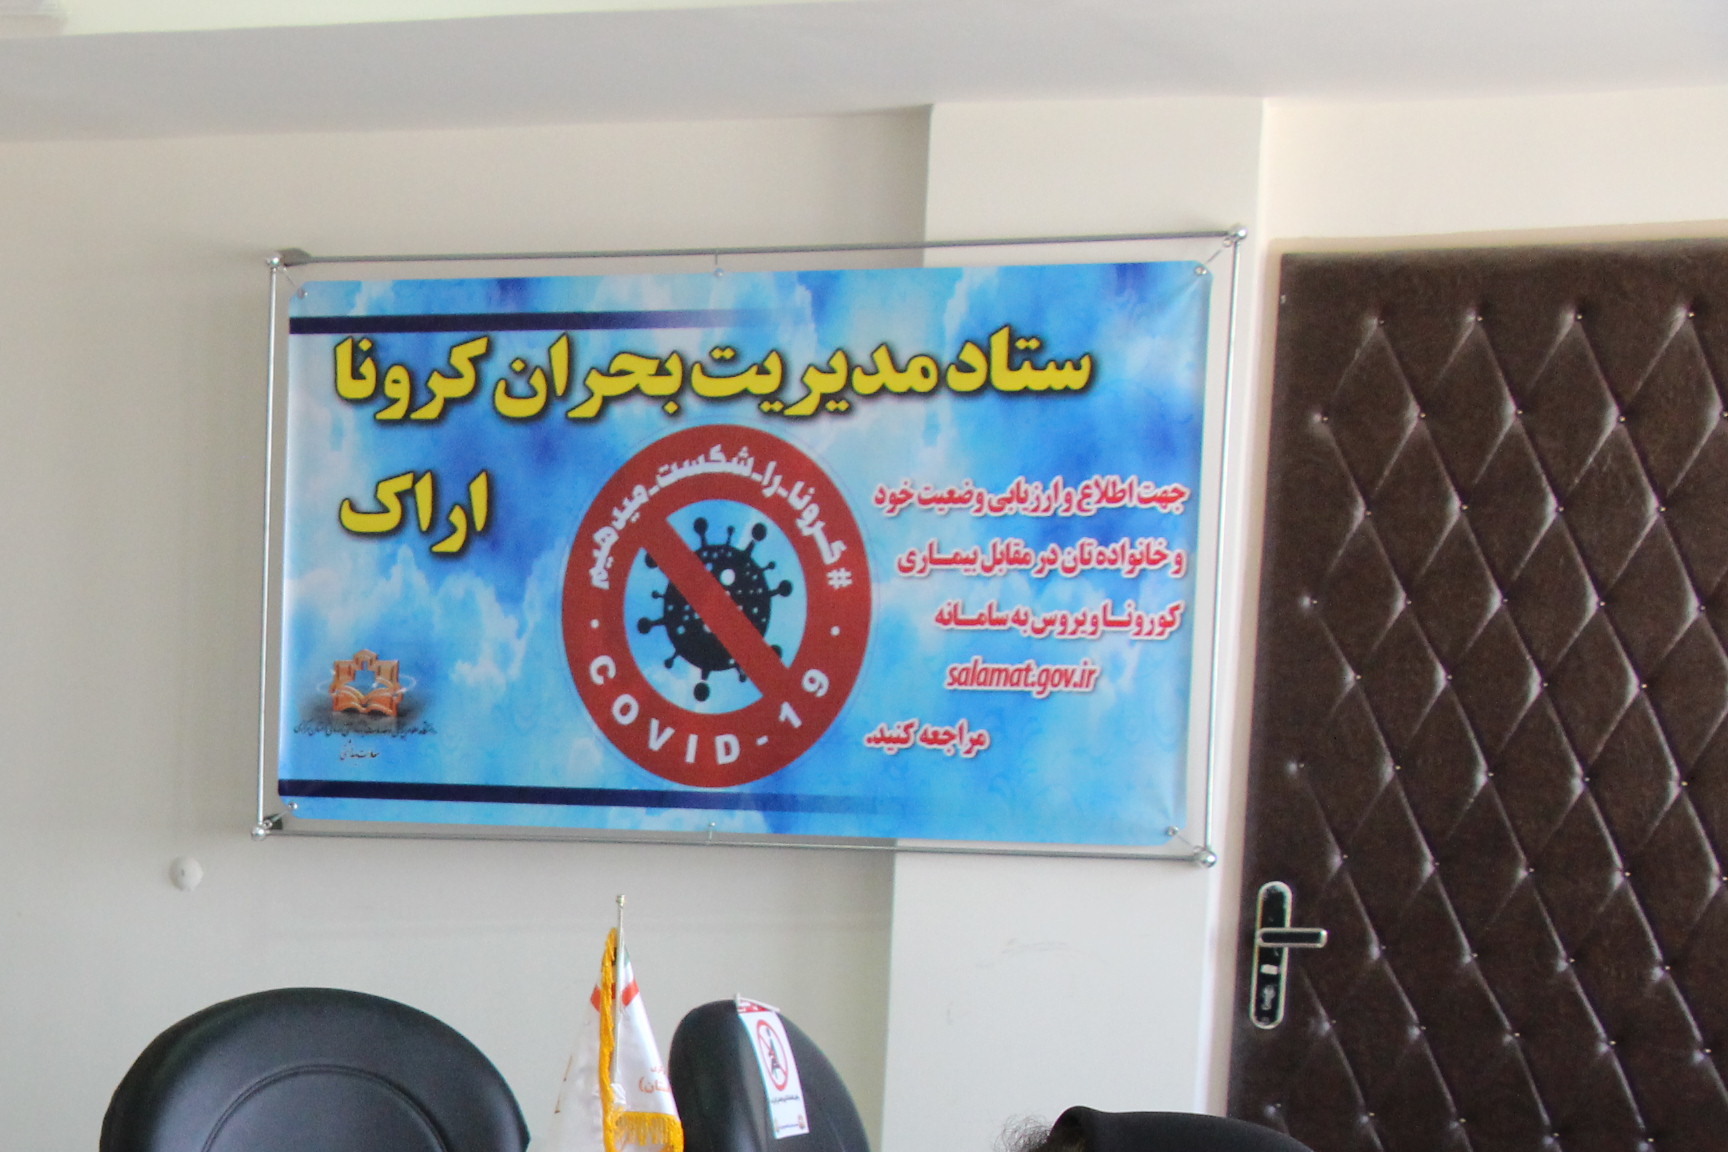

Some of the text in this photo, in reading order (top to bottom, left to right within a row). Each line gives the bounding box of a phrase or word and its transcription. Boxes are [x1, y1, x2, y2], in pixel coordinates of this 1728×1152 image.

[332, 323, 1093, 421] ستاد مدیریت بحران کرونا
[338, 470, 489, 553] اراک
[873, 483, 914, 515] خود
[919, 481, 985, 514] وضعیت
[1077, 476, 1136, 514] اطلاع
[1138, 484, 1188, 514] جهت
[980, 540, 1033, 573] مقابل
[1034, 546, 1058, 575] در
[1171, 550, 1184, 575] و
[945, 655, 1098, 697] salamat.gov.ir
[588, 654, 831, 766] COVID-19
[918, 719, 989, 755] مراجعه
